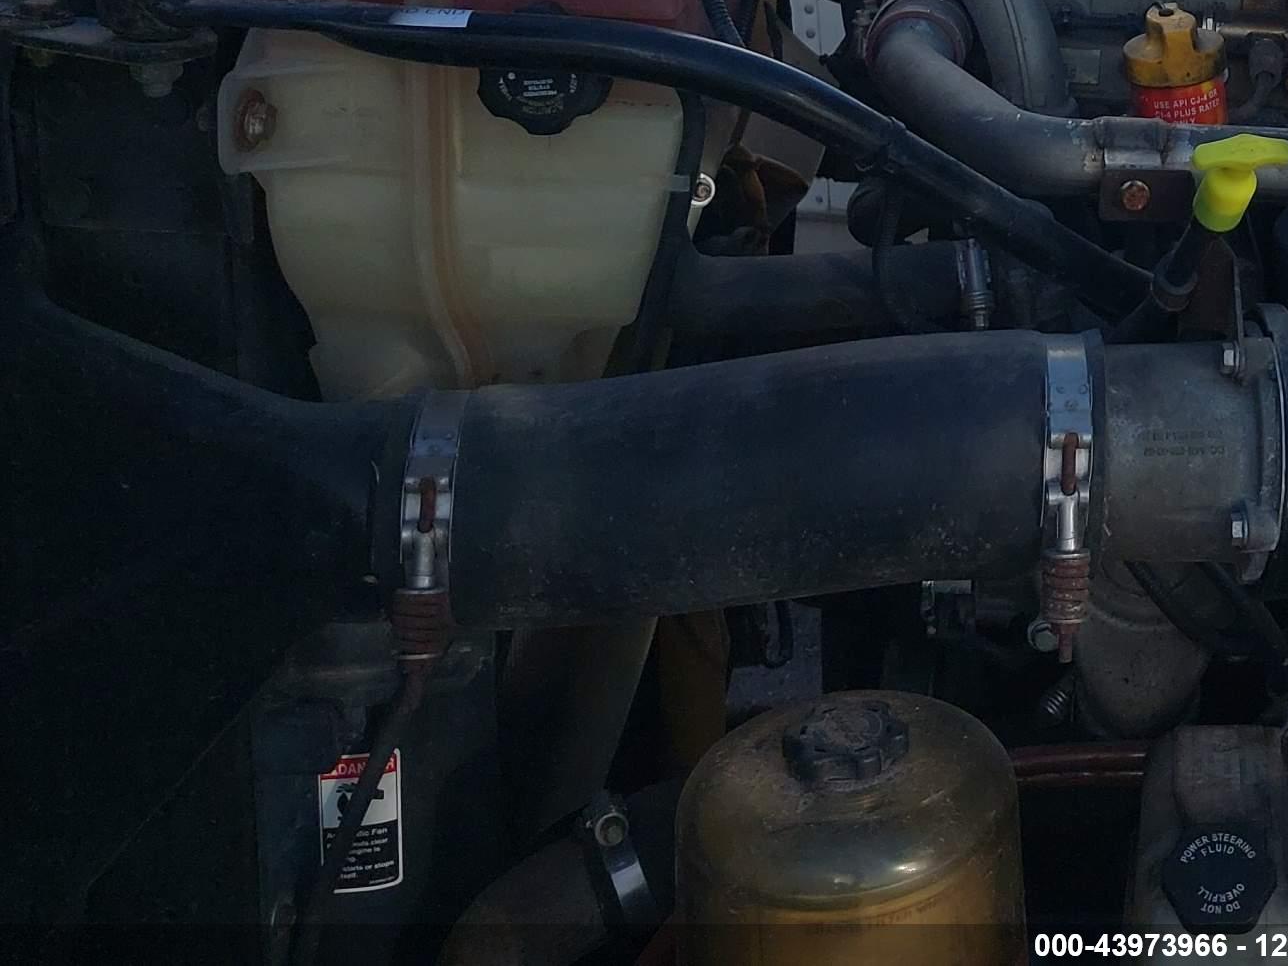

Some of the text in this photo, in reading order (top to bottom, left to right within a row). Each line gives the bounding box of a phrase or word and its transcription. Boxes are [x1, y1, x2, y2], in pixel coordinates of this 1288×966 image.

[1154, 100, 1170, 109] USE
[1173, 98, 1188, 108] API
[1174, 106, 1197, 119] PLUS
[1180, 833, 1256, 863] POWER STEERING
[1200, 844, 1235, 857] FLUID
[1198, 883, 1245, 902] OVERFILL
[1200, 901, 1241, 914] DO NOT
